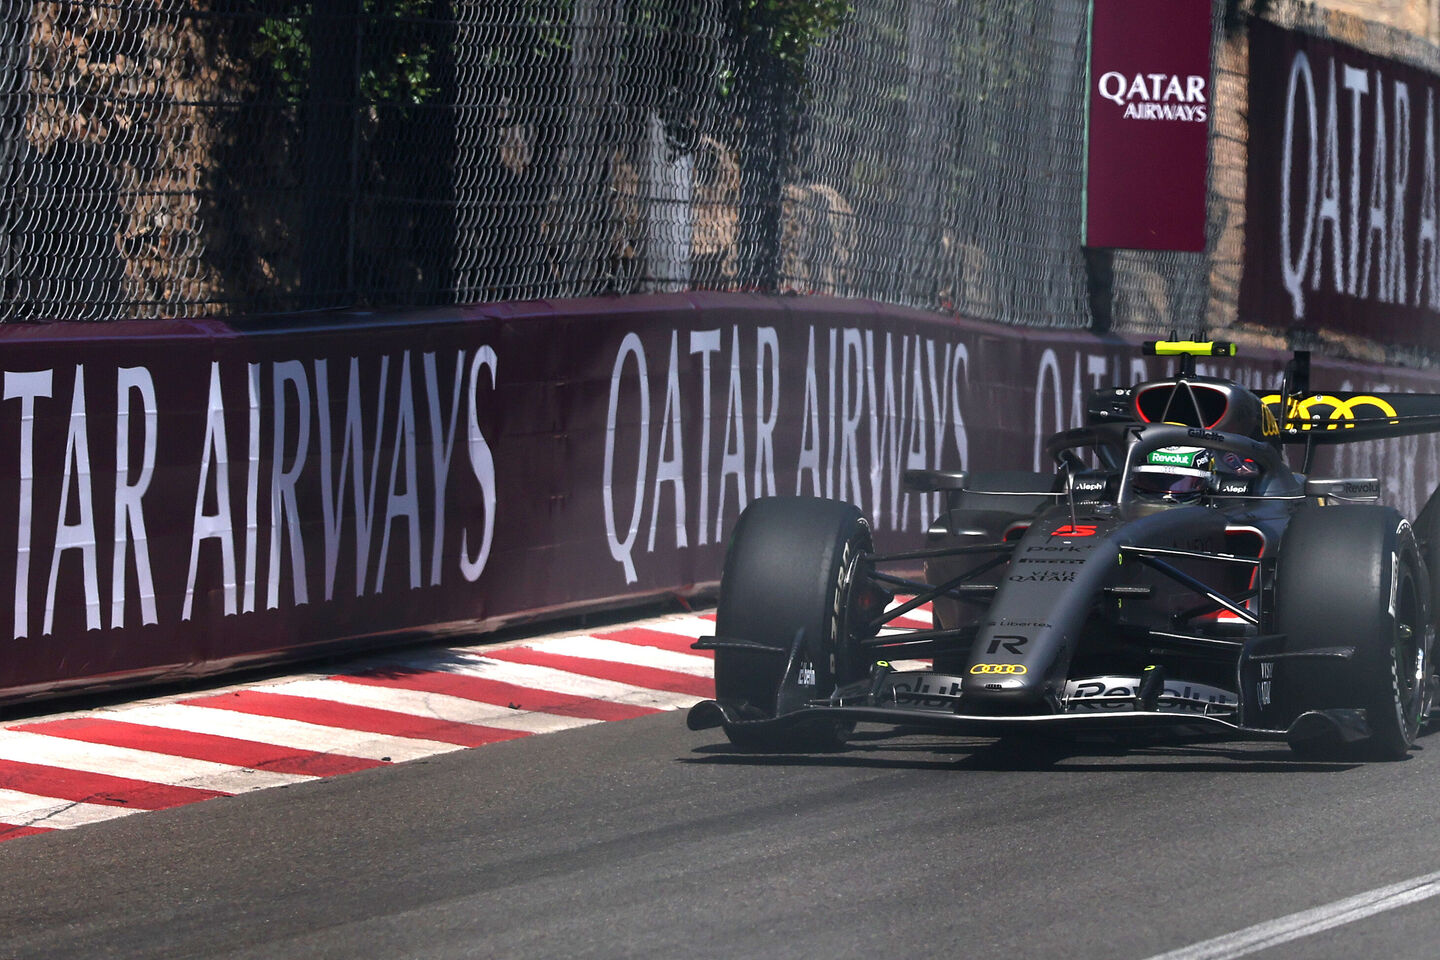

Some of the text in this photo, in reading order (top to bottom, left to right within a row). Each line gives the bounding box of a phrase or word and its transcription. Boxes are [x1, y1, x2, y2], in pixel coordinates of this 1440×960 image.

[1098, 71, 1206, 106] QATAR
[1123, 102, 1207, 122] AIRWAYS
[1281, 49, 1411, 320] QATAR
[603, 324, 970, 585] QATAR AIRWAYS
[1152, 452, 1190, 465] Revolut
[3, 344, 498, 640] TAR AIRWAYS
[1076, 482, 1103, 491] Aleph
[1051, 524, 1098, 538] 5
[1008, 575, 1076, 583] QATAR
[986, 635, 1029, 655] R
